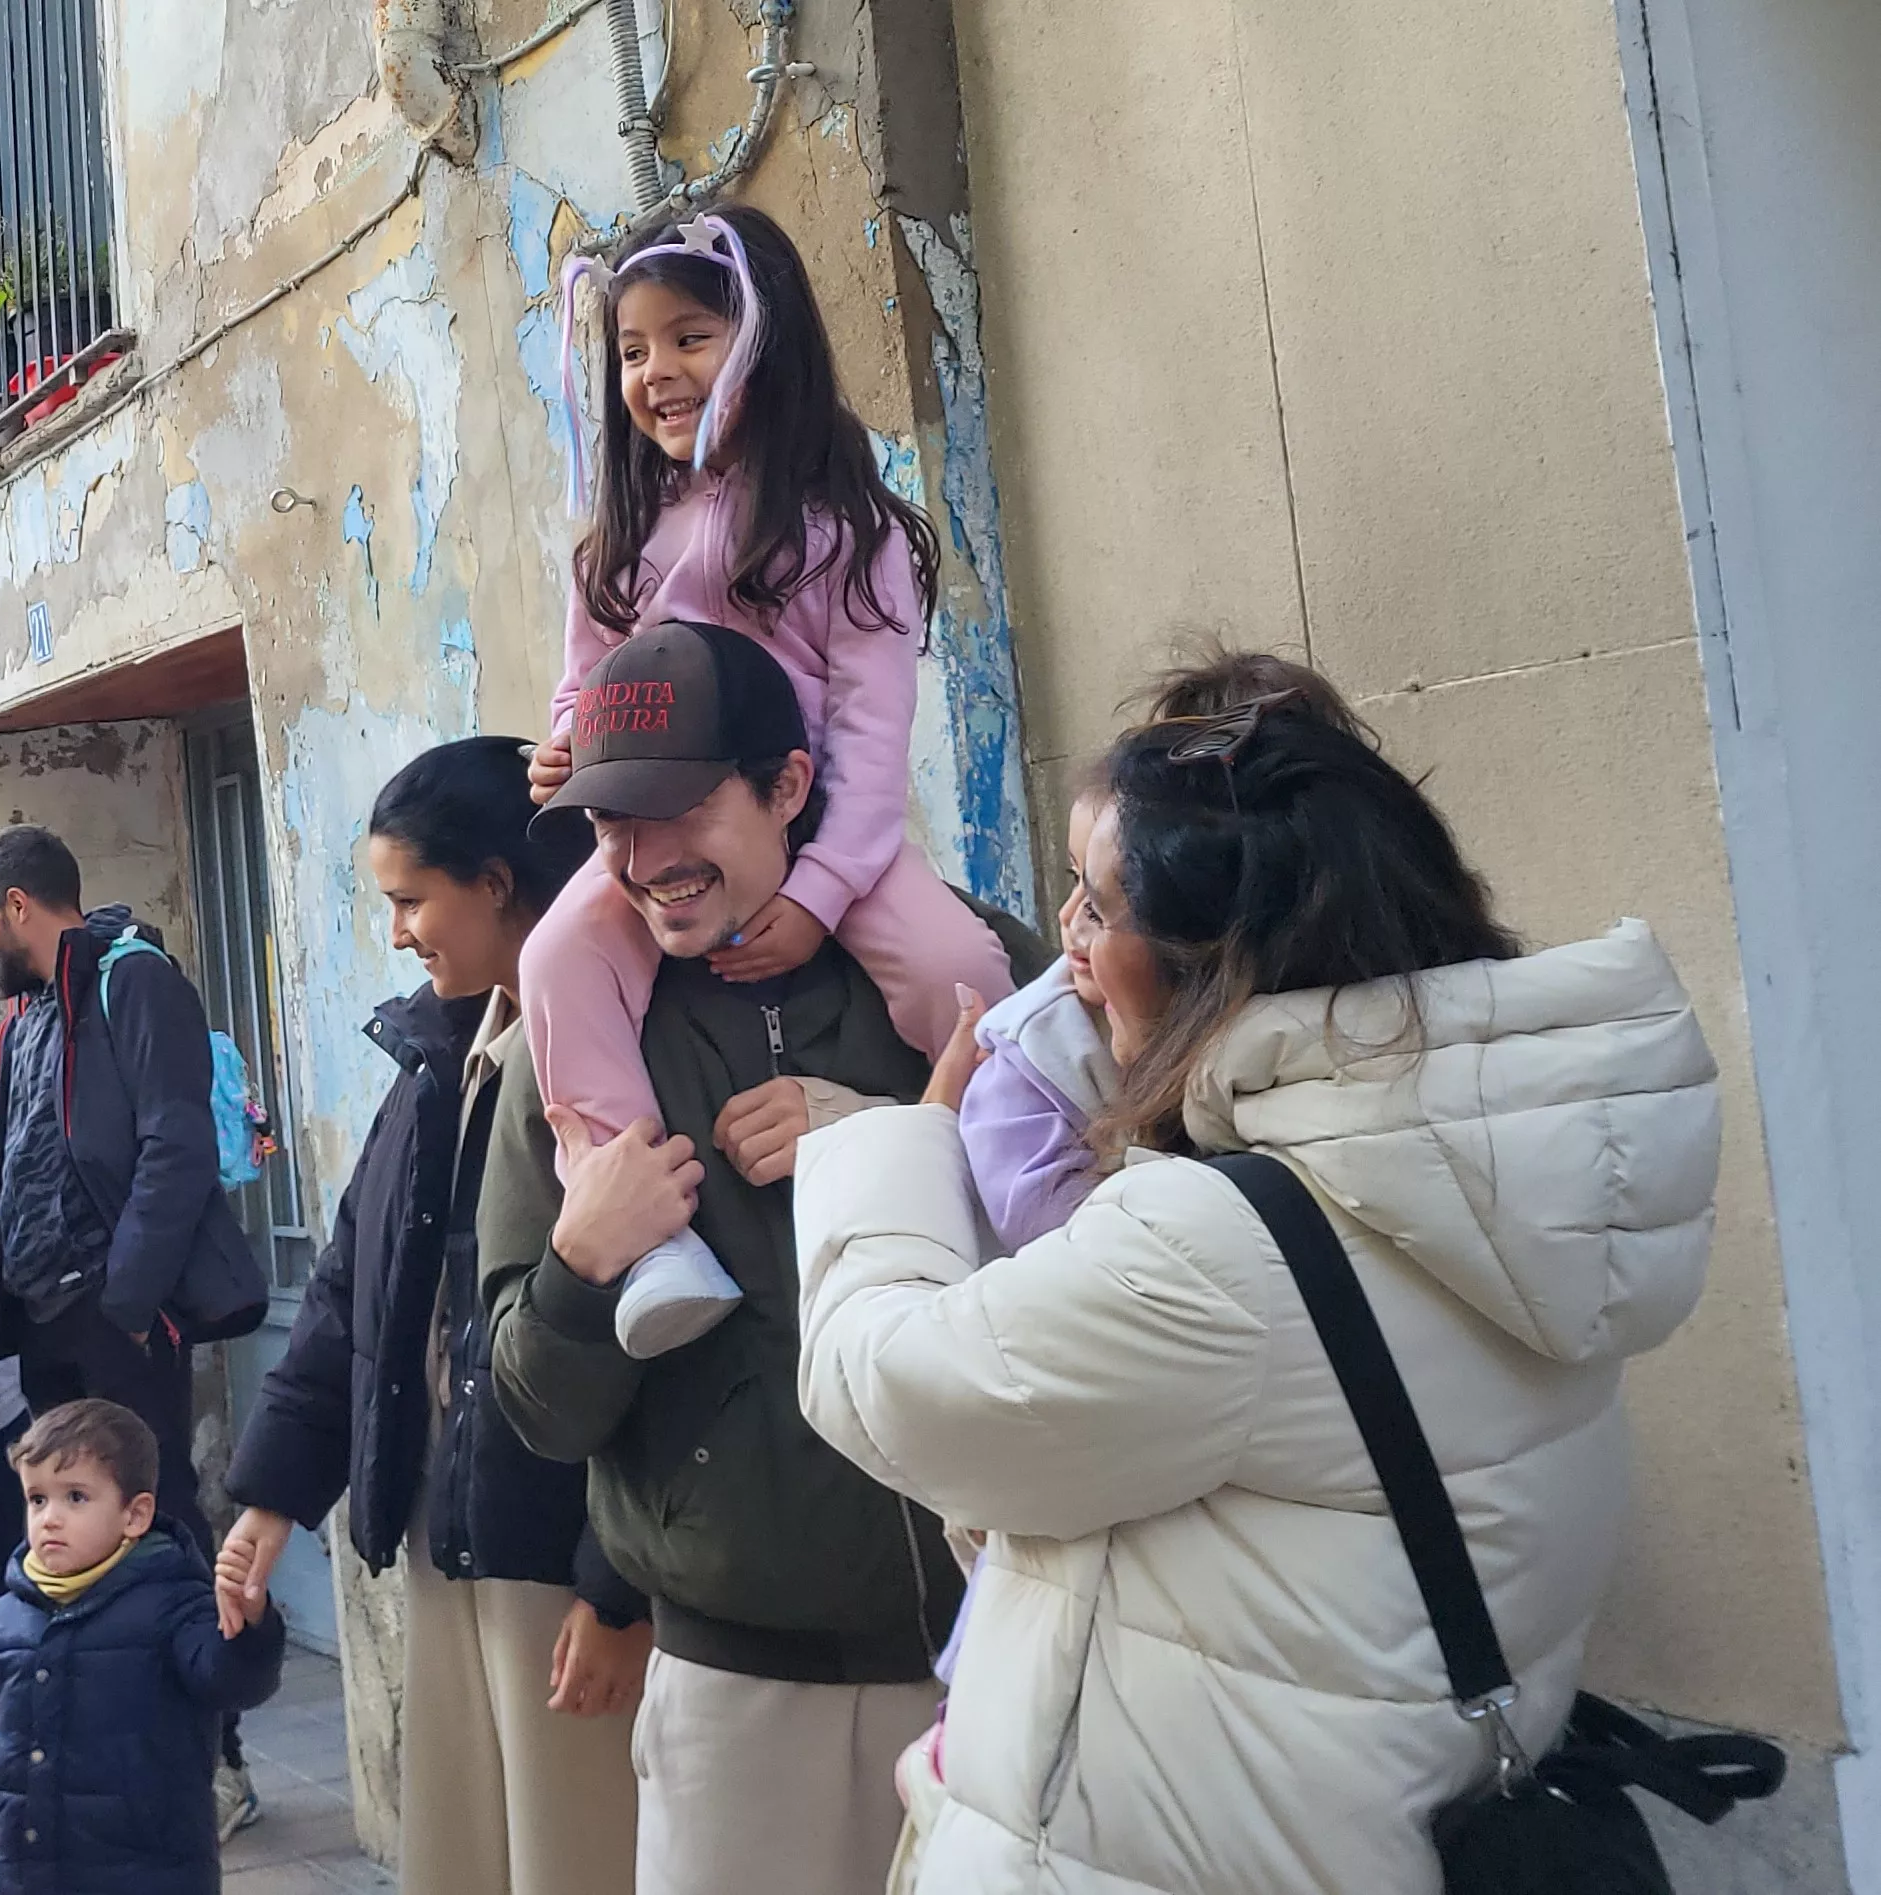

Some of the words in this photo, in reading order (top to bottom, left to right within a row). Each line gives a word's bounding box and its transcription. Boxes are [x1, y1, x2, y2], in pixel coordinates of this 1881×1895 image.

[31, 607, 50, 658] 21
[577, 681, 676, 717] BENDITA
[576, 708, 669, 748] LOCURA
